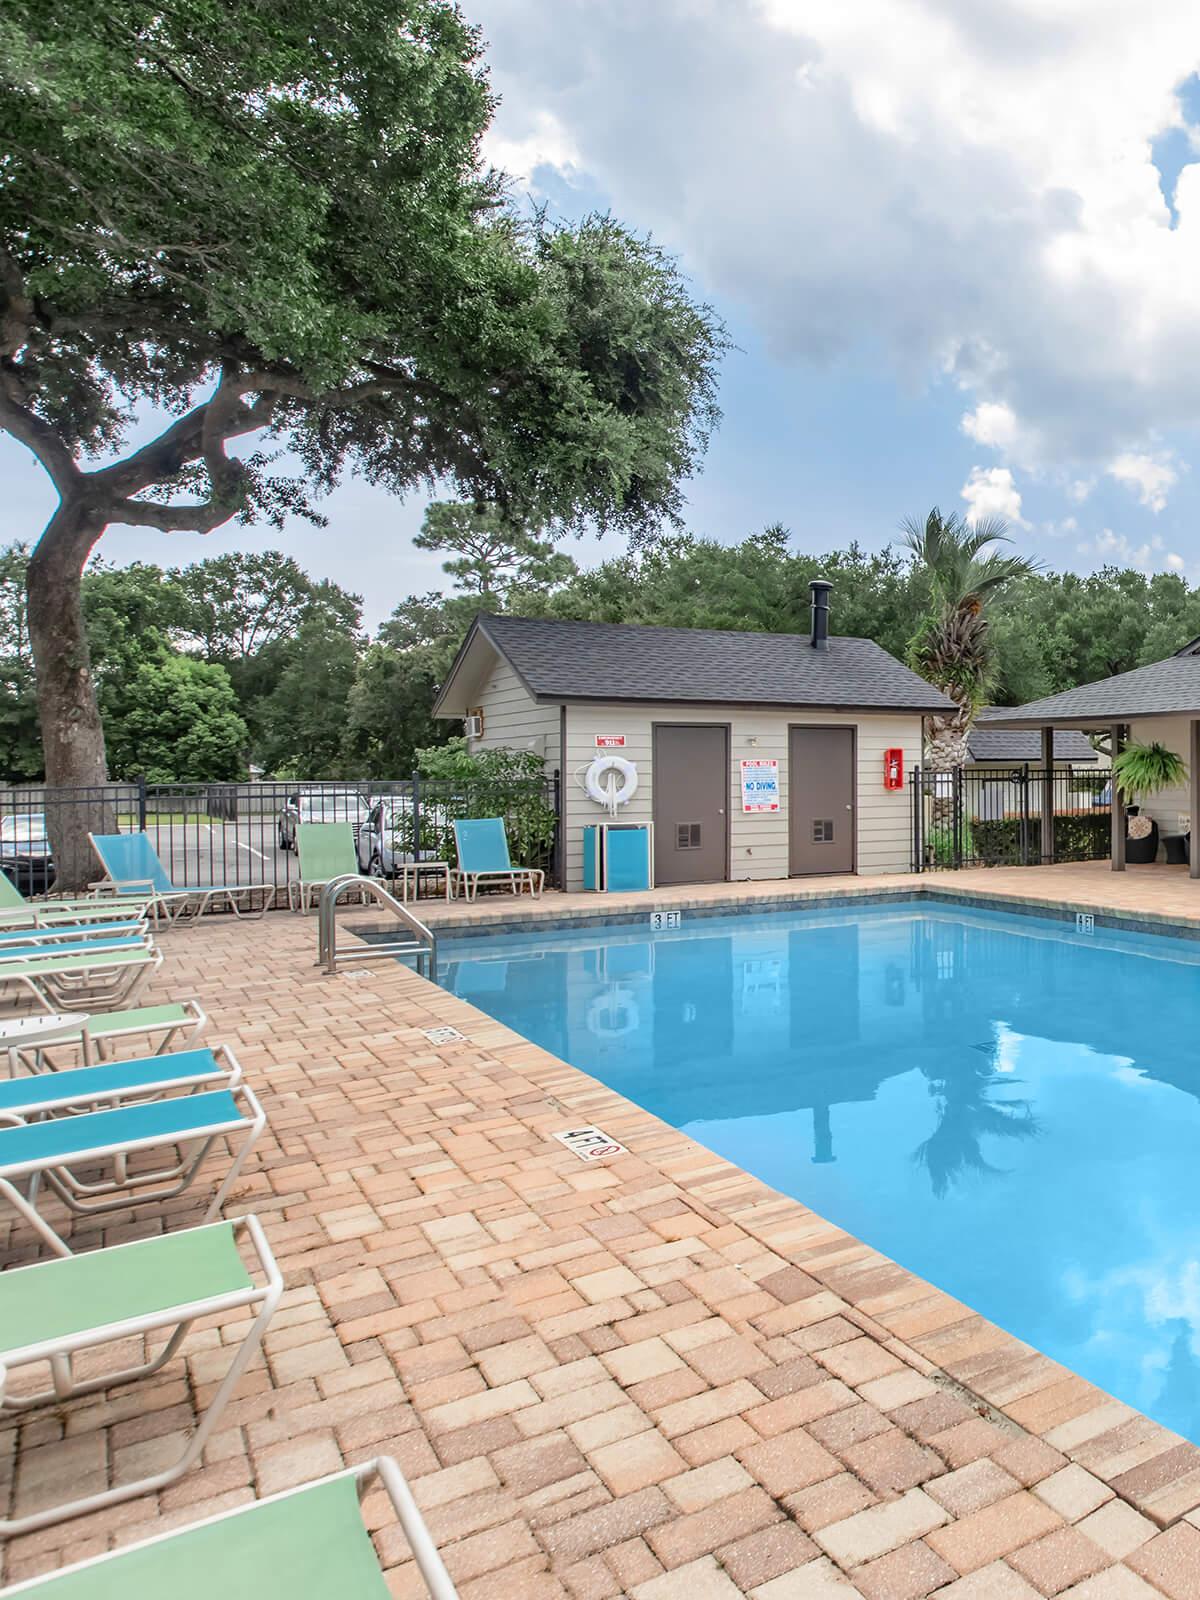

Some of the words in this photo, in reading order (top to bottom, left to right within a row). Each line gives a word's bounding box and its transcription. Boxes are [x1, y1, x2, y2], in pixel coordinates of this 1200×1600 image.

[746, 782, 755, 790] NO
[756, 782, 776, 790] DIVING
[667, 912, 680, 921] FT
[563, 1130, 594, 1139] 4
[570, 1136, 609, 1149] FT
